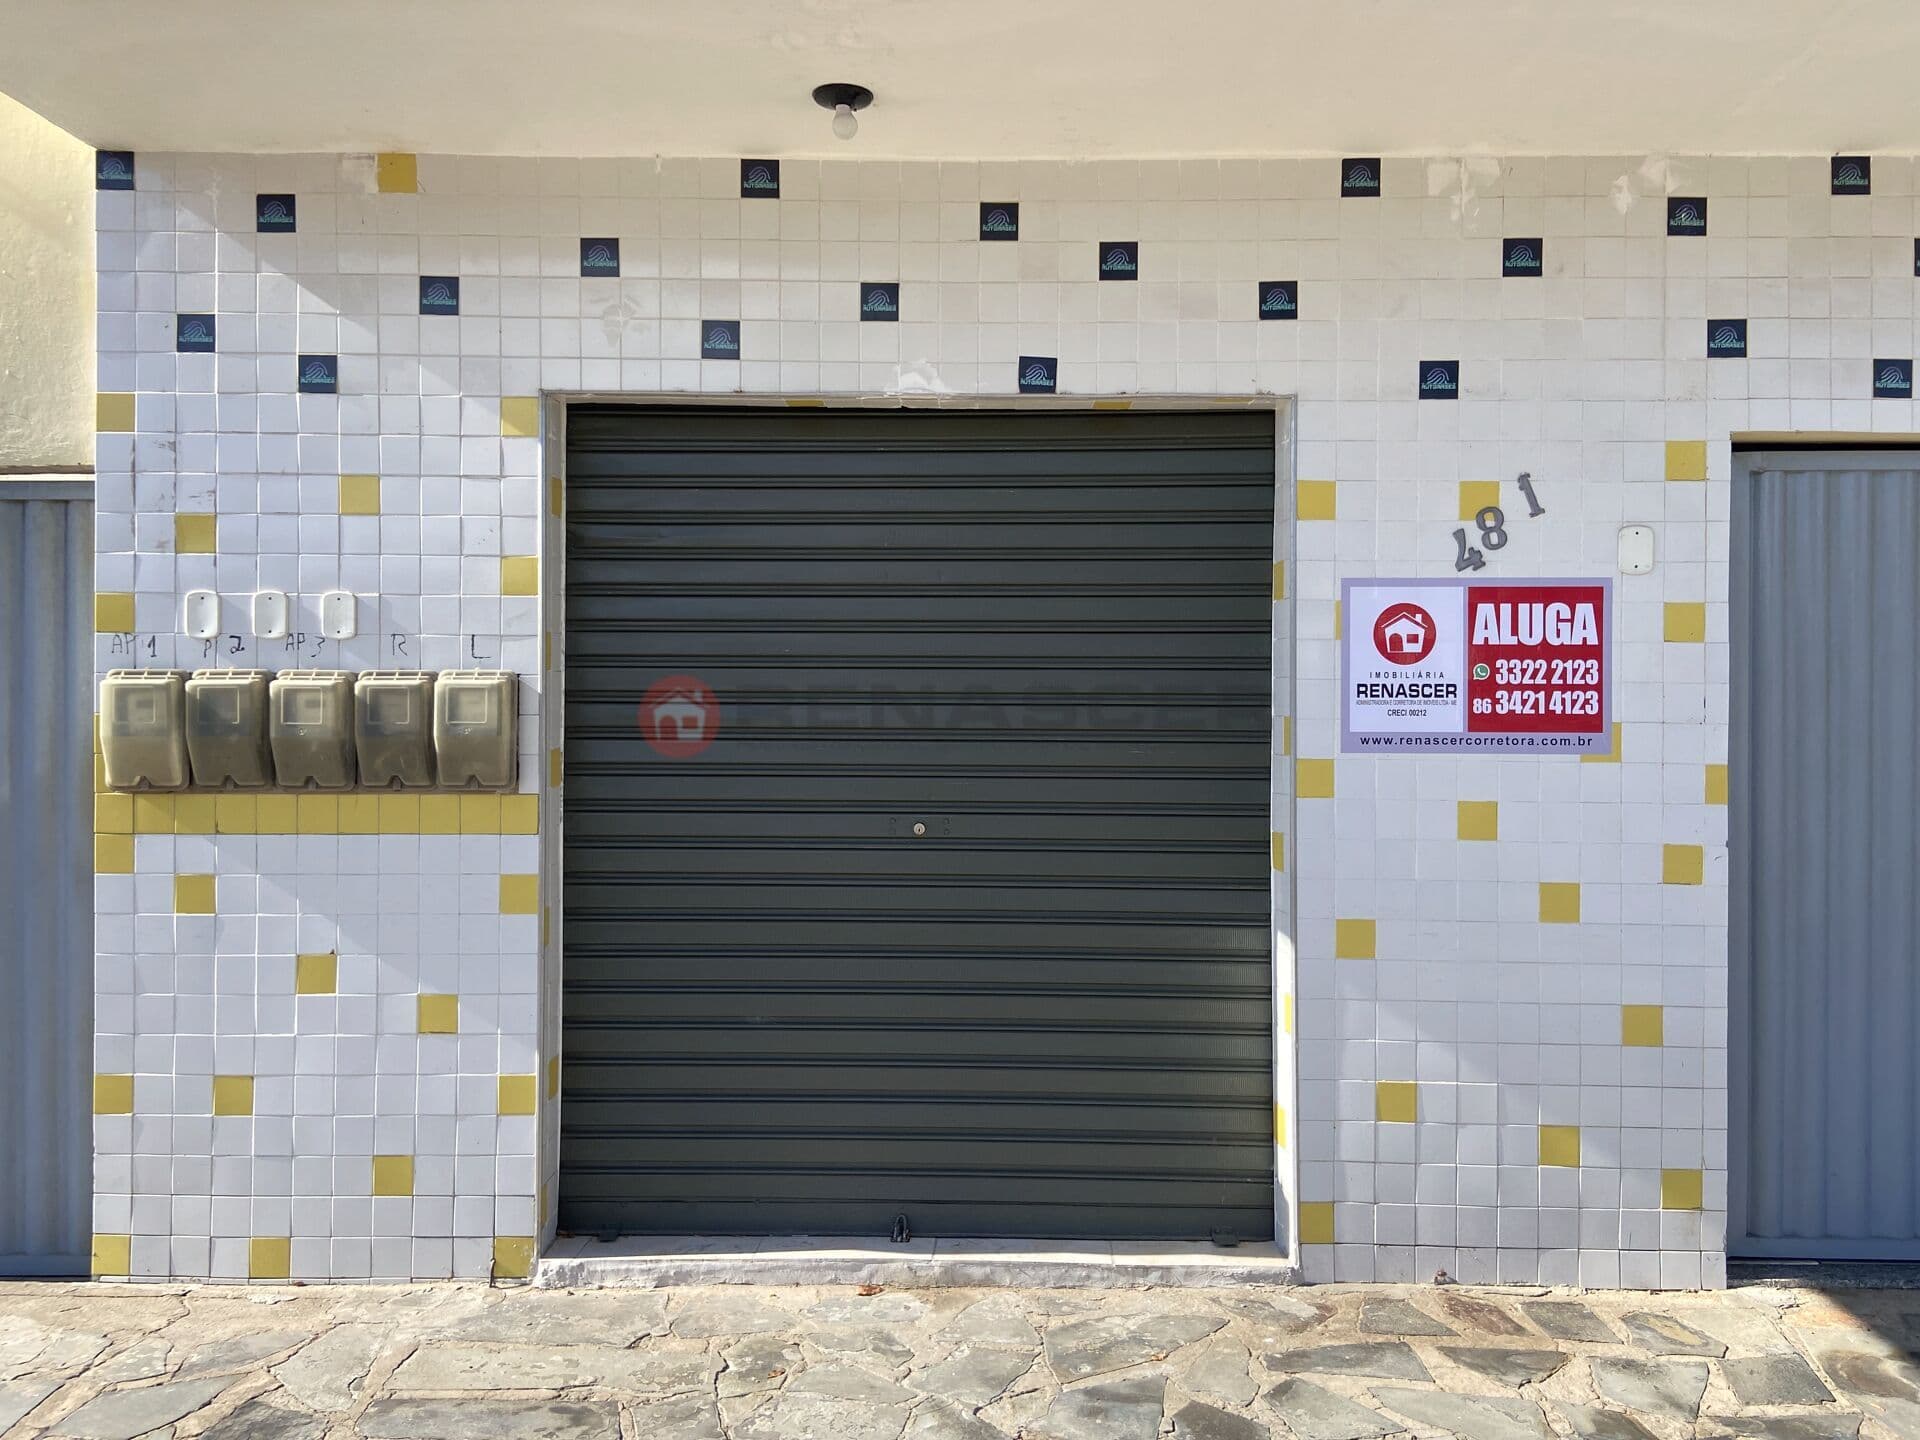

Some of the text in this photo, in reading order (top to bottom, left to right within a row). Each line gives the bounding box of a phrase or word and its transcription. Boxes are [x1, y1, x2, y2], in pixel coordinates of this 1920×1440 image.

[1452, 472, 1546, 572] 481
[1472, 602, 1599, 646] ALUGA
[111, 632, 157, 657] AP 1
[229, 635, 245, 654] 2
[286, 633, 326, 657] AP 3
[391, 633, 408, 656] R
[471, 634, 492, 659] L
[1369, 670, 1444, 679] IMOBILIÁRIA
[1495, 659, 1599, 685] 3322 2123
[1356, 683, 1457, 698] RENASCER
[1472, 690, 1599, 715] 86 3421 4123
[1387, 709, 1427, 717] CRECI 00212
[1360, 735, 1593, 746] www.renascercorretora.com.br
